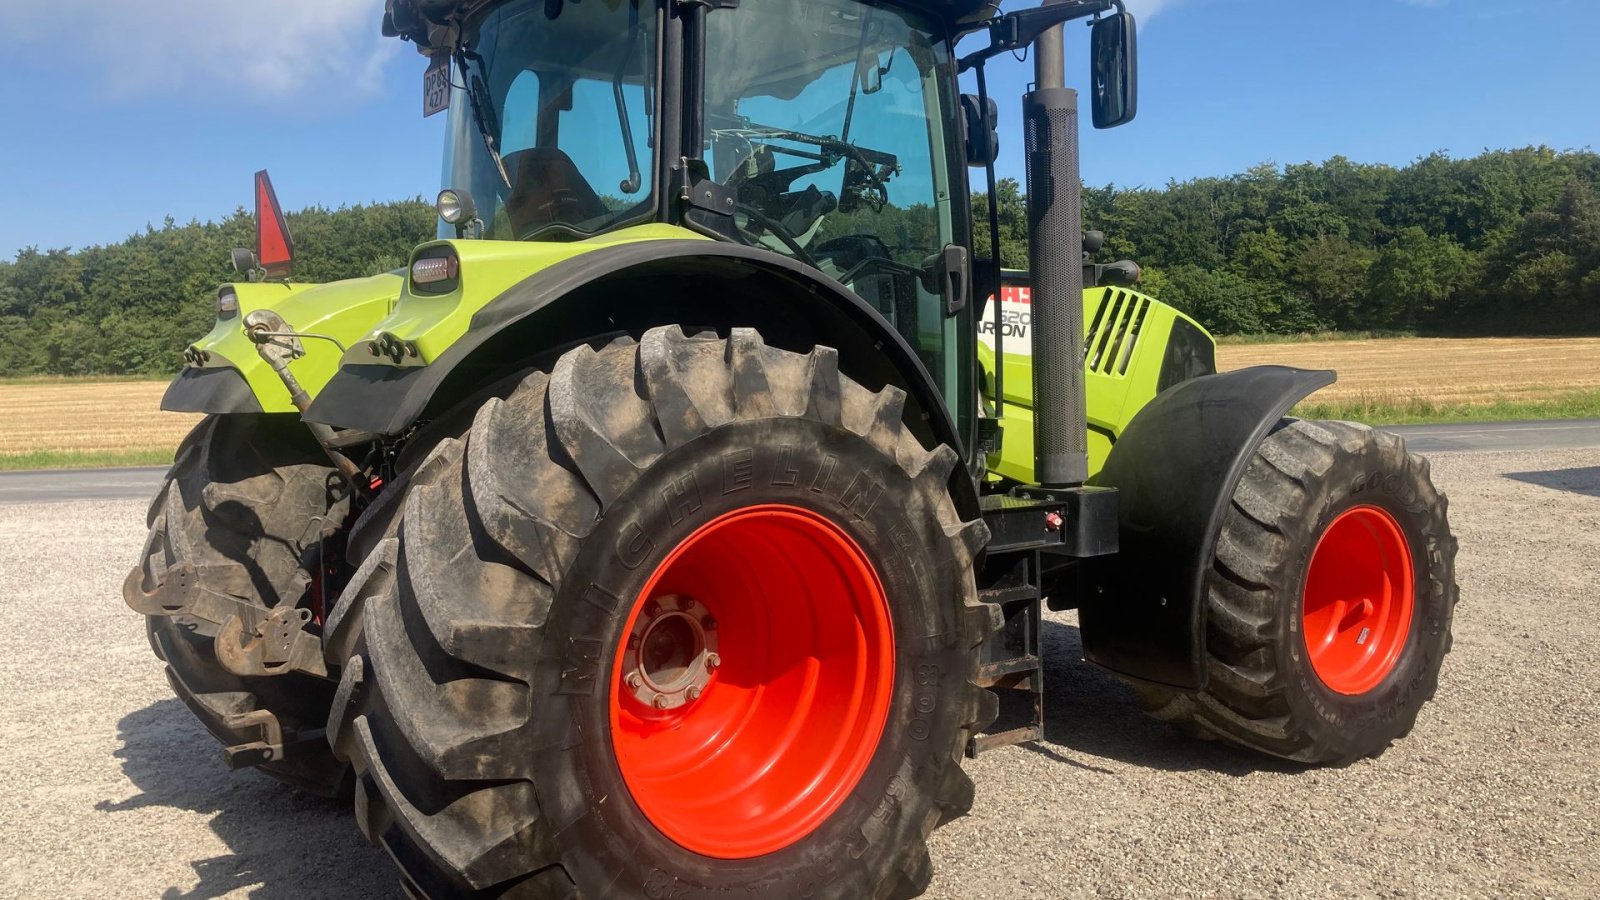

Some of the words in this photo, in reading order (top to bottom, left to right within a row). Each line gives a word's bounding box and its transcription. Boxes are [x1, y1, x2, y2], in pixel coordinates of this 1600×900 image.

[429, 89, 443, 108] 427
[977, 321, 1026, 338] RON
[552, 445, 886, 696] MICHELIN
